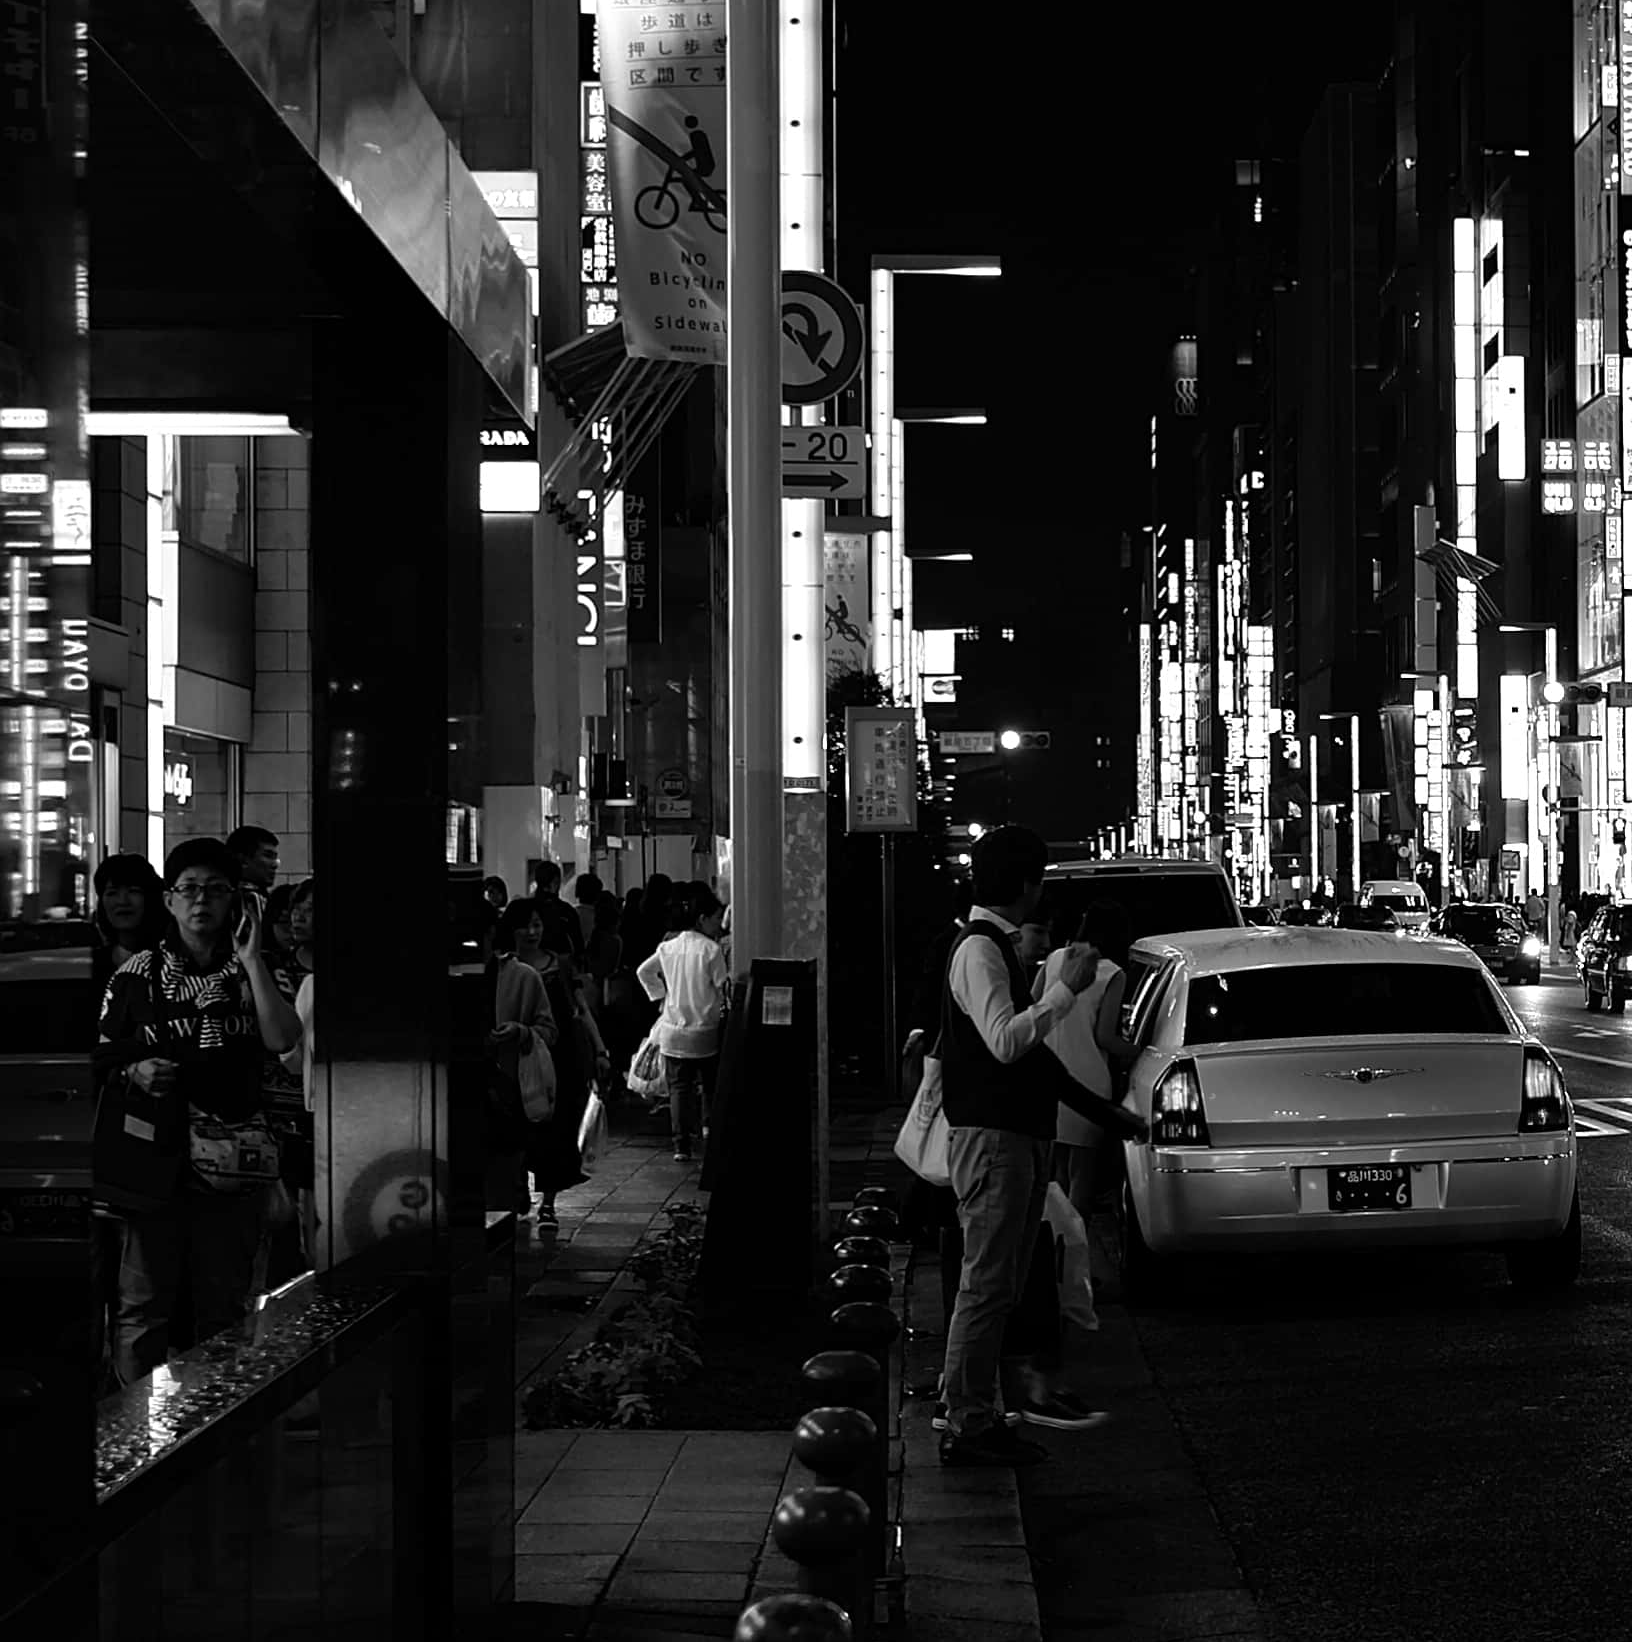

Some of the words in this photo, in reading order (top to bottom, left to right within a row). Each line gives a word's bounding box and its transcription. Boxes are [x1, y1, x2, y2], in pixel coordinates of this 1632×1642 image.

[681, 252, 706, 266] NO
[650, 272, 726, 290] Bicyclin
[688, 298, 707, 309] on
[655, 316, 727, 333] Sidewal
[480, 430, 530, 447] RADA
[624, 493, 649, 609] みずほ銀行
[142, 1017, 198, 1046] NW
